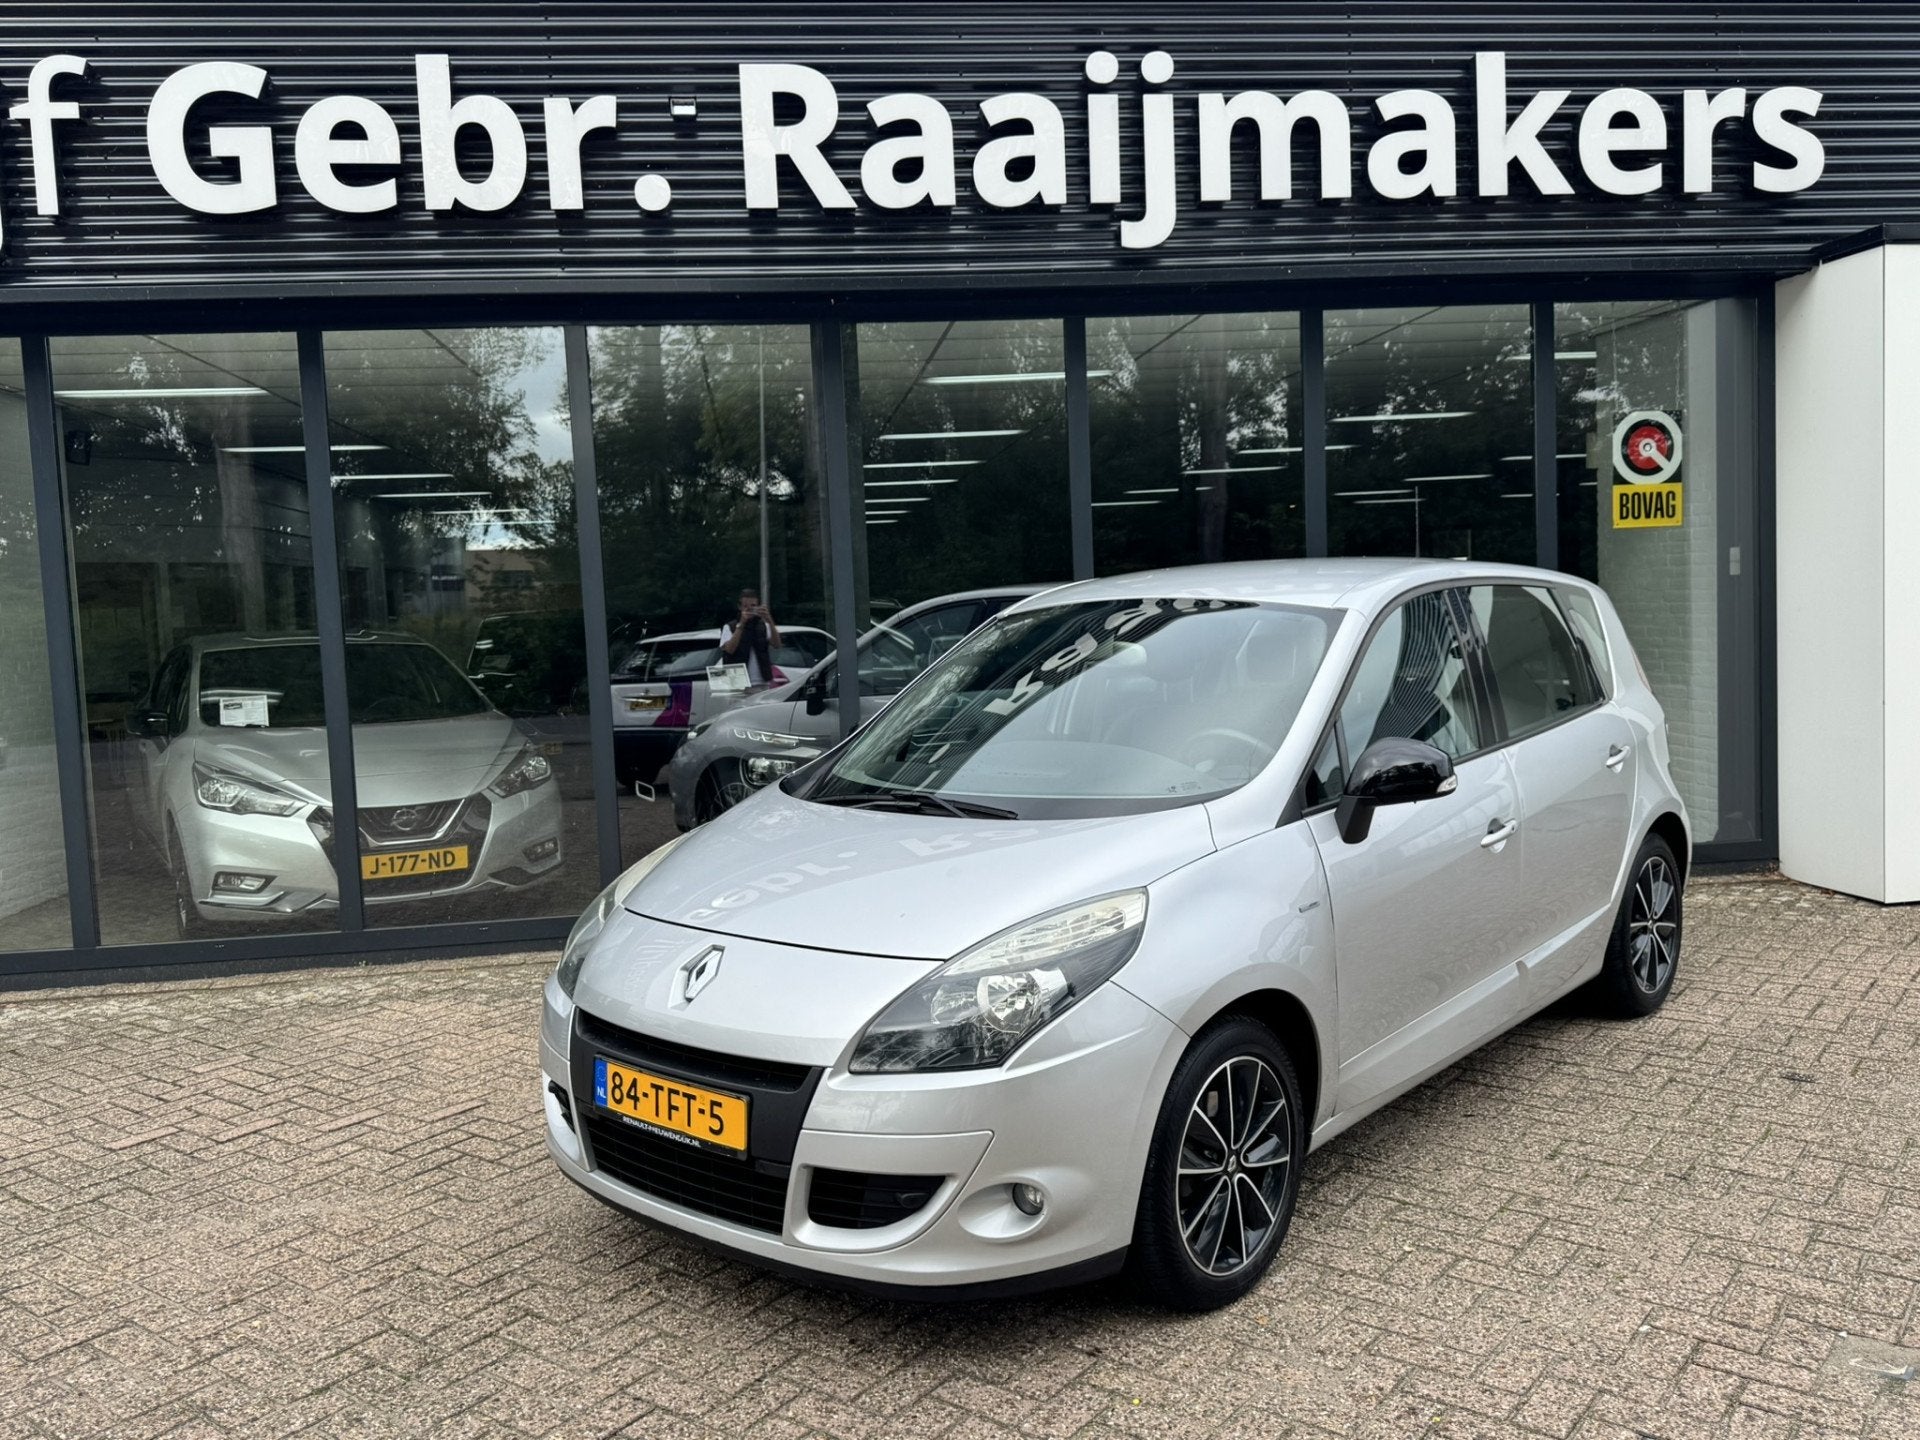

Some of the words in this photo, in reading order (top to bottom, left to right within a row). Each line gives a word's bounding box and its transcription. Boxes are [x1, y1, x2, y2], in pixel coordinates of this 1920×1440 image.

[0, 54, 87, 250] f
[146, 53, 672, 214] Gebr.
[738, 50, 1826, 249] Raaijmakers
[1619, 490, 1676, 520] BOVAG
[370, 850, 456, 875] J-177-ND
[597, 1085, 607, 1099] NL
[611, 1071, 724, 1136] 84-TFT-5
